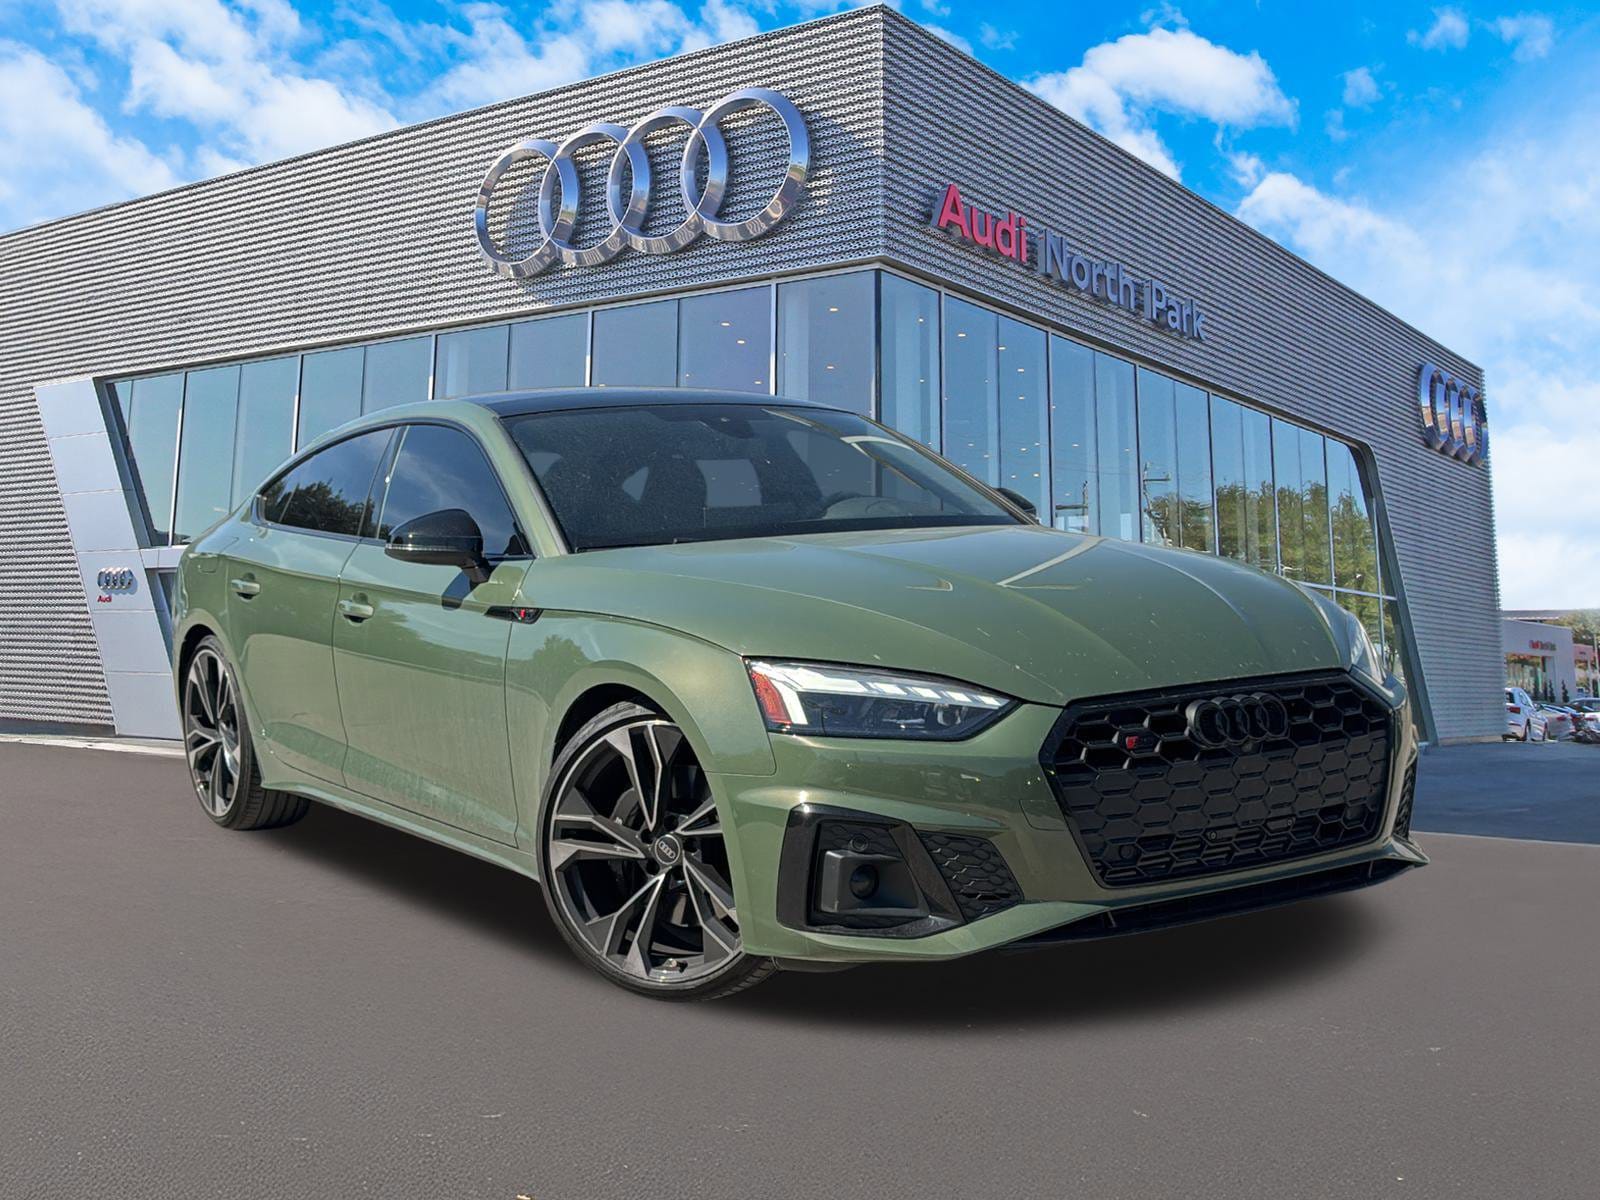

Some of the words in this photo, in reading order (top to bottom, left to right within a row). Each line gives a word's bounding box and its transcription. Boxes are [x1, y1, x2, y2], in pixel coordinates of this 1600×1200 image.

[934, 183, 1027, 263] Audi
[1040, 229, 1136, 312] North
[1145, 279, 1207, 341] Park
